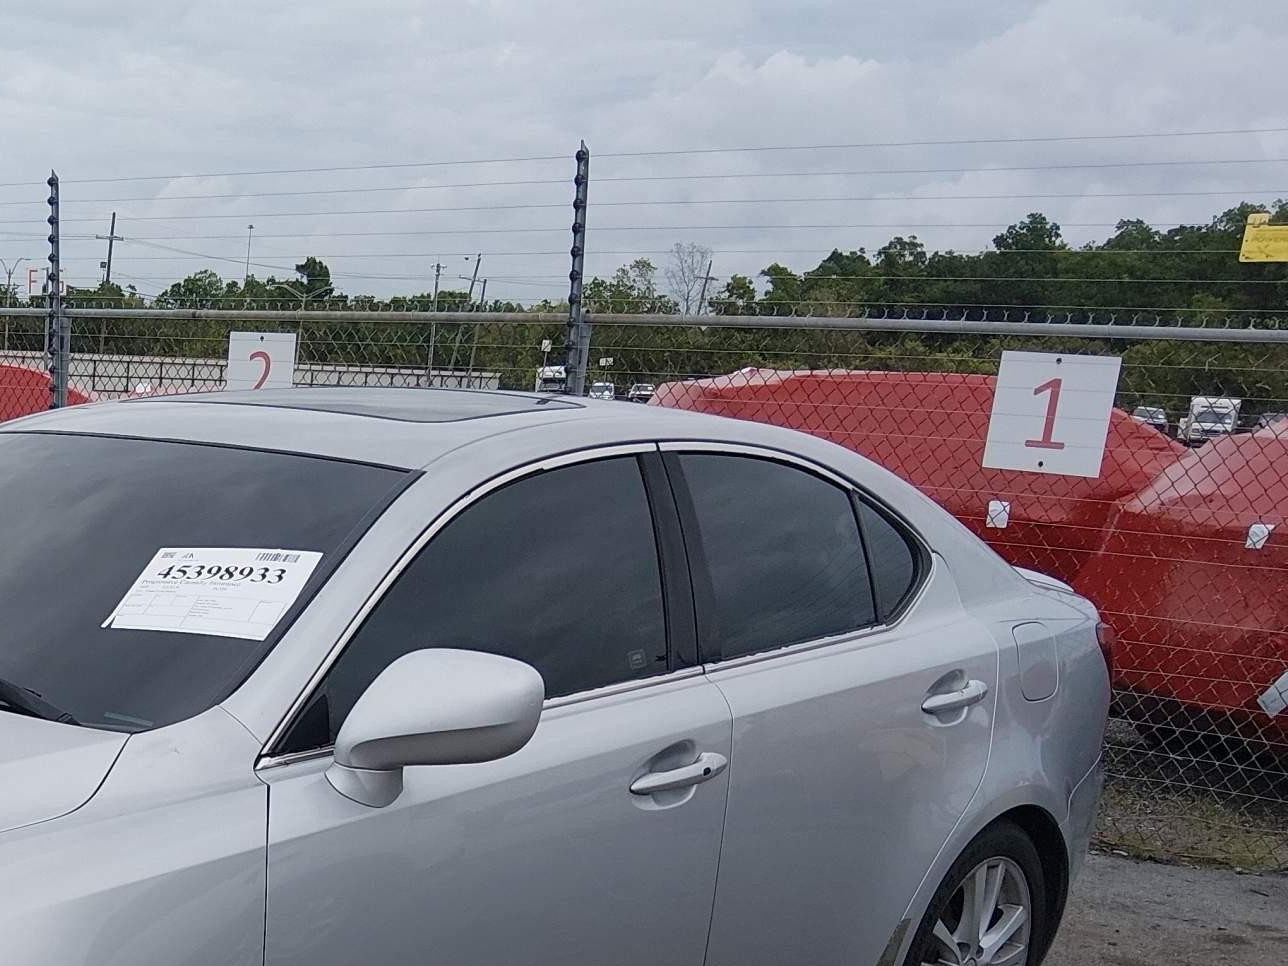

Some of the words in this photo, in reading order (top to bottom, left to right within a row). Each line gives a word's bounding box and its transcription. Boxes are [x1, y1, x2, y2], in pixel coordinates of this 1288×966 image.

[249, 350, 271, 390] 2
[1024, 377, 1065, 450] 1
[157, 564, 287, 584] 45398933
